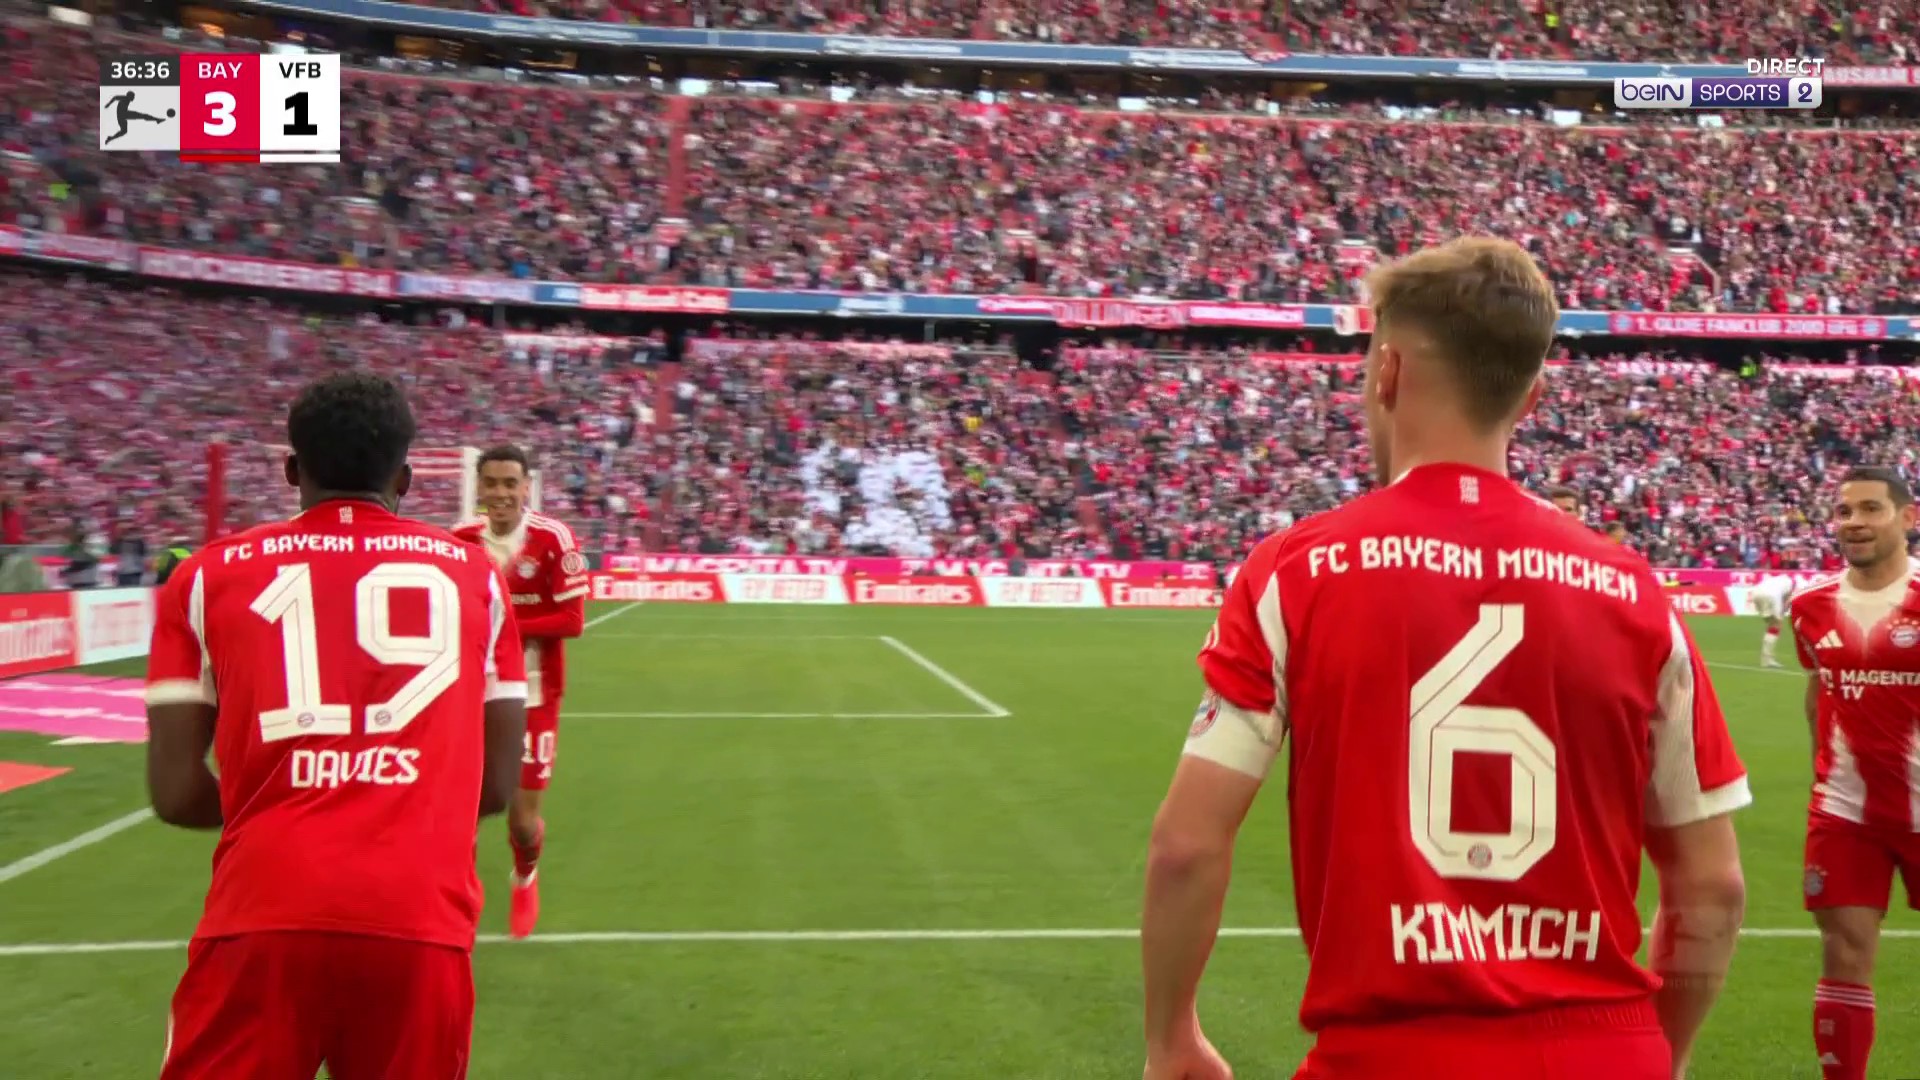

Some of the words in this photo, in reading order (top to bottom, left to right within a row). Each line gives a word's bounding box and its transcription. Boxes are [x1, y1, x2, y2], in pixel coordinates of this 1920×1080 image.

[223, 543, 253, 564] FC
[262, 533, 353, 554] BAYERN
[364, 534, 468, 563] MÜNCHEN
[1307, 543, 1349, 579] FC
[1359, 535, 1483, 580] BAYERN
[1497, 546, 1638, 605] MÜNCHEN
[249, 562, 461, 744] 19
[1840, 685, 1866, 701] TV
[291, 745, 421, 789] DAVIES
[1408, 603, 1557, 882] 6
[1390, 903, 1600, 965] KIMMICH
